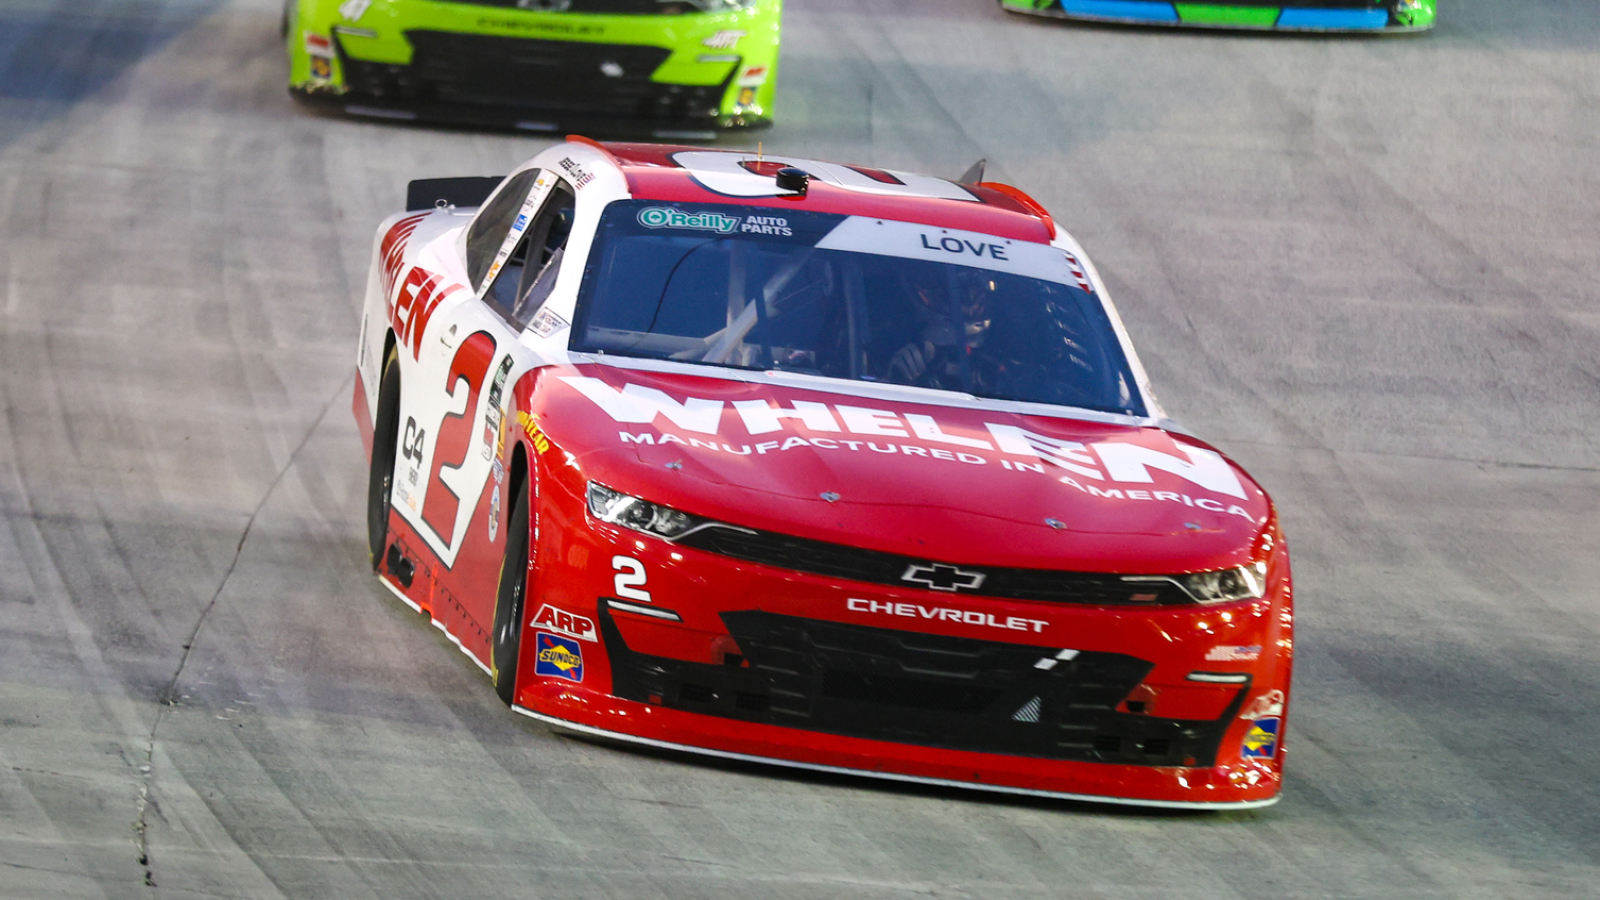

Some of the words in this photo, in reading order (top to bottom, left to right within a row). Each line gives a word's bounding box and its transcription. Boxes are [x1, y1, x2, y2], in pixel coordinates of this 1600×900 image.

[641, 208, 738, 233] O'Reilly
[746, 215, 788, 227] AUTO
[741, 223, 793, 236] PARTS
[920, 233, 1010, 261] LOVE
[402, 415, 426, 470] C4
[421, 330, 497, 551] 2
[555, 376, 1248, 500] WHELEN
[618, 431, 987, 465] MANUFACTURED
[1000, 459, 1045, 474] IN
[1059, 476, 1256, 524] AMERICA
[612, 554, 652, 602] 2
[534, 604, 594, 639] ARP
[847, 598, 1049, 633] CHEVROLET
[540, 649, 582, 668] SUNOCO
